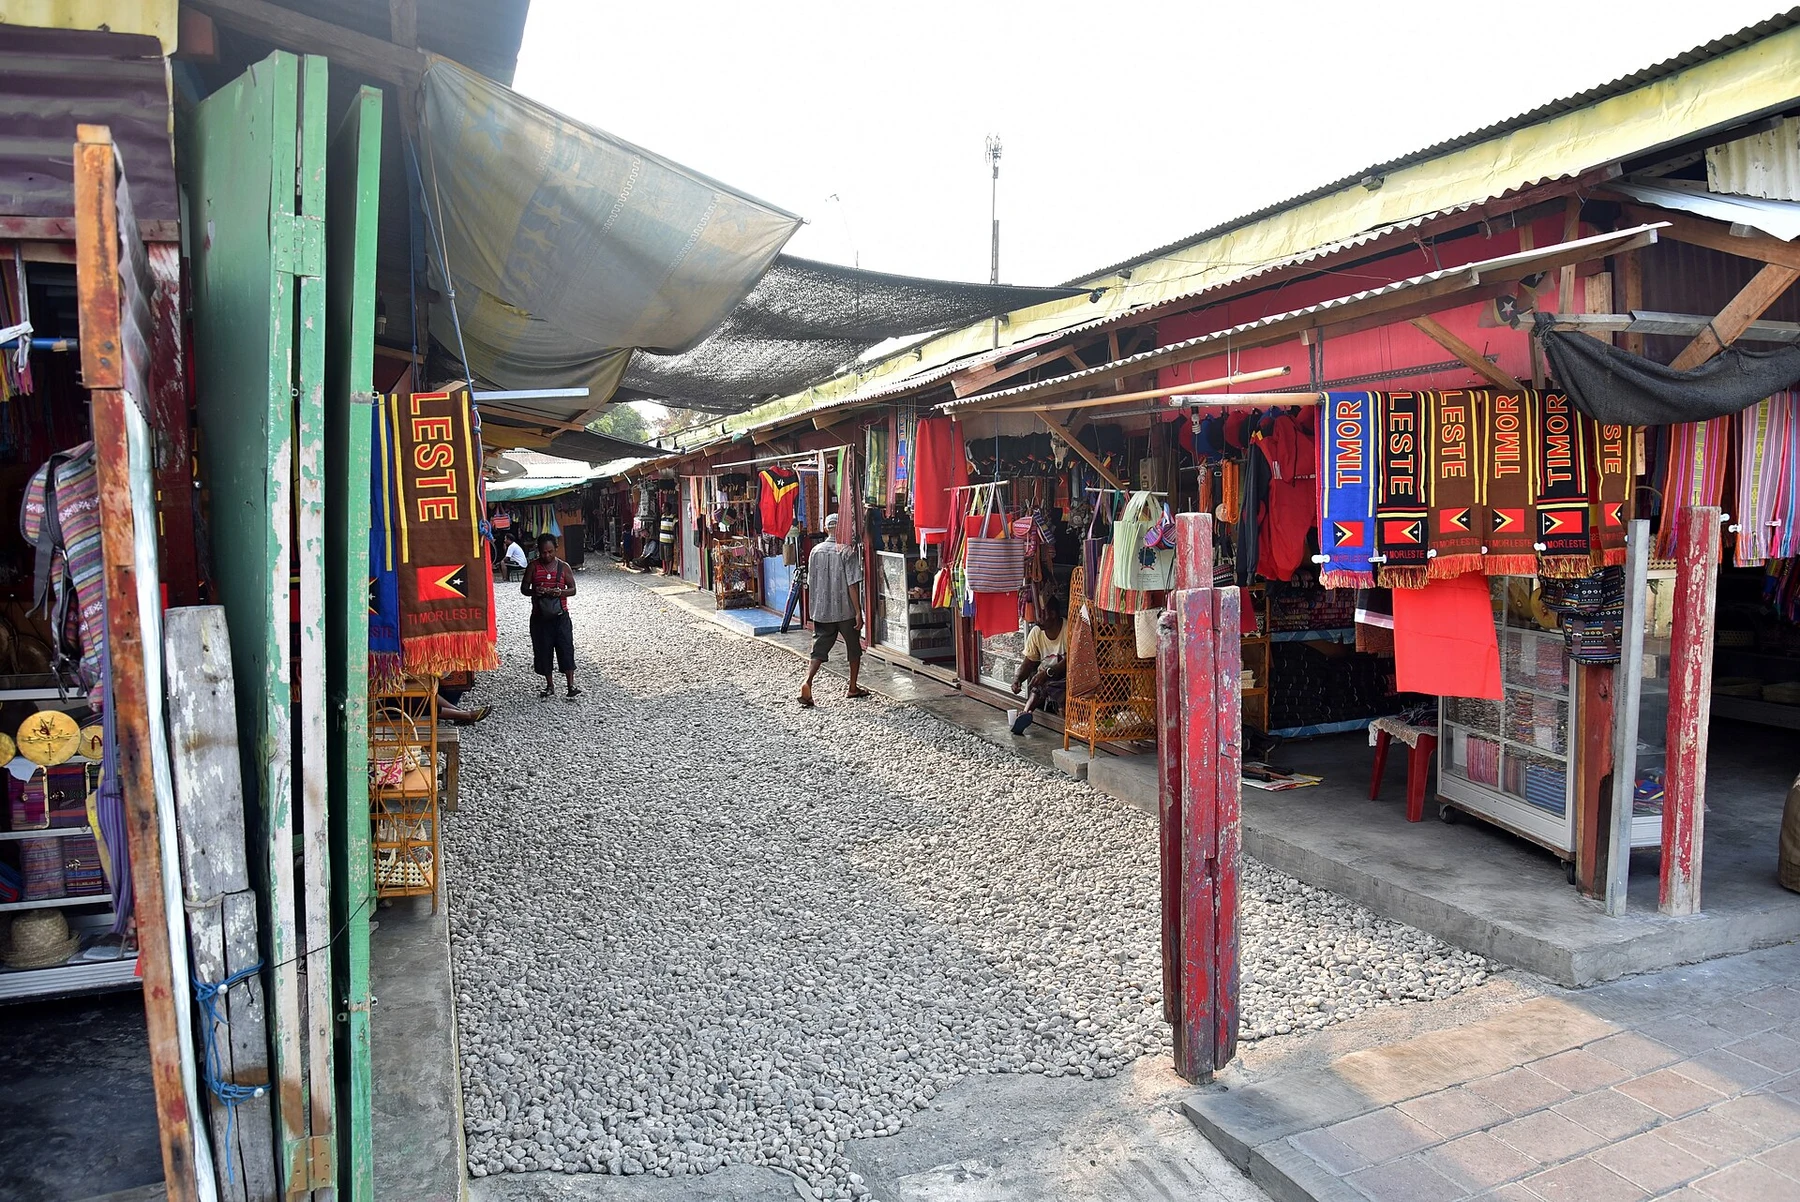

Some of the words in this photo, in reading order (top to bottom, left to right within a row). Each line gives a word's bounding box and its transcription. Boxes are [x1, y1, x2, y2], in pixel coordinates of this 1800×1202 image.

[410, 392, 458, 522] LESTE
[1336, 400, 1361, 489] TIMOR
[1388, 392, 1413, 495] LESTE
[1439, 391, 1466, 478] LESTE
[1495, 395, 1520, 479] TIMOR
[1546, 394, 1571, 487] TIMOR
[1603, 424, 1622, 474] STE
